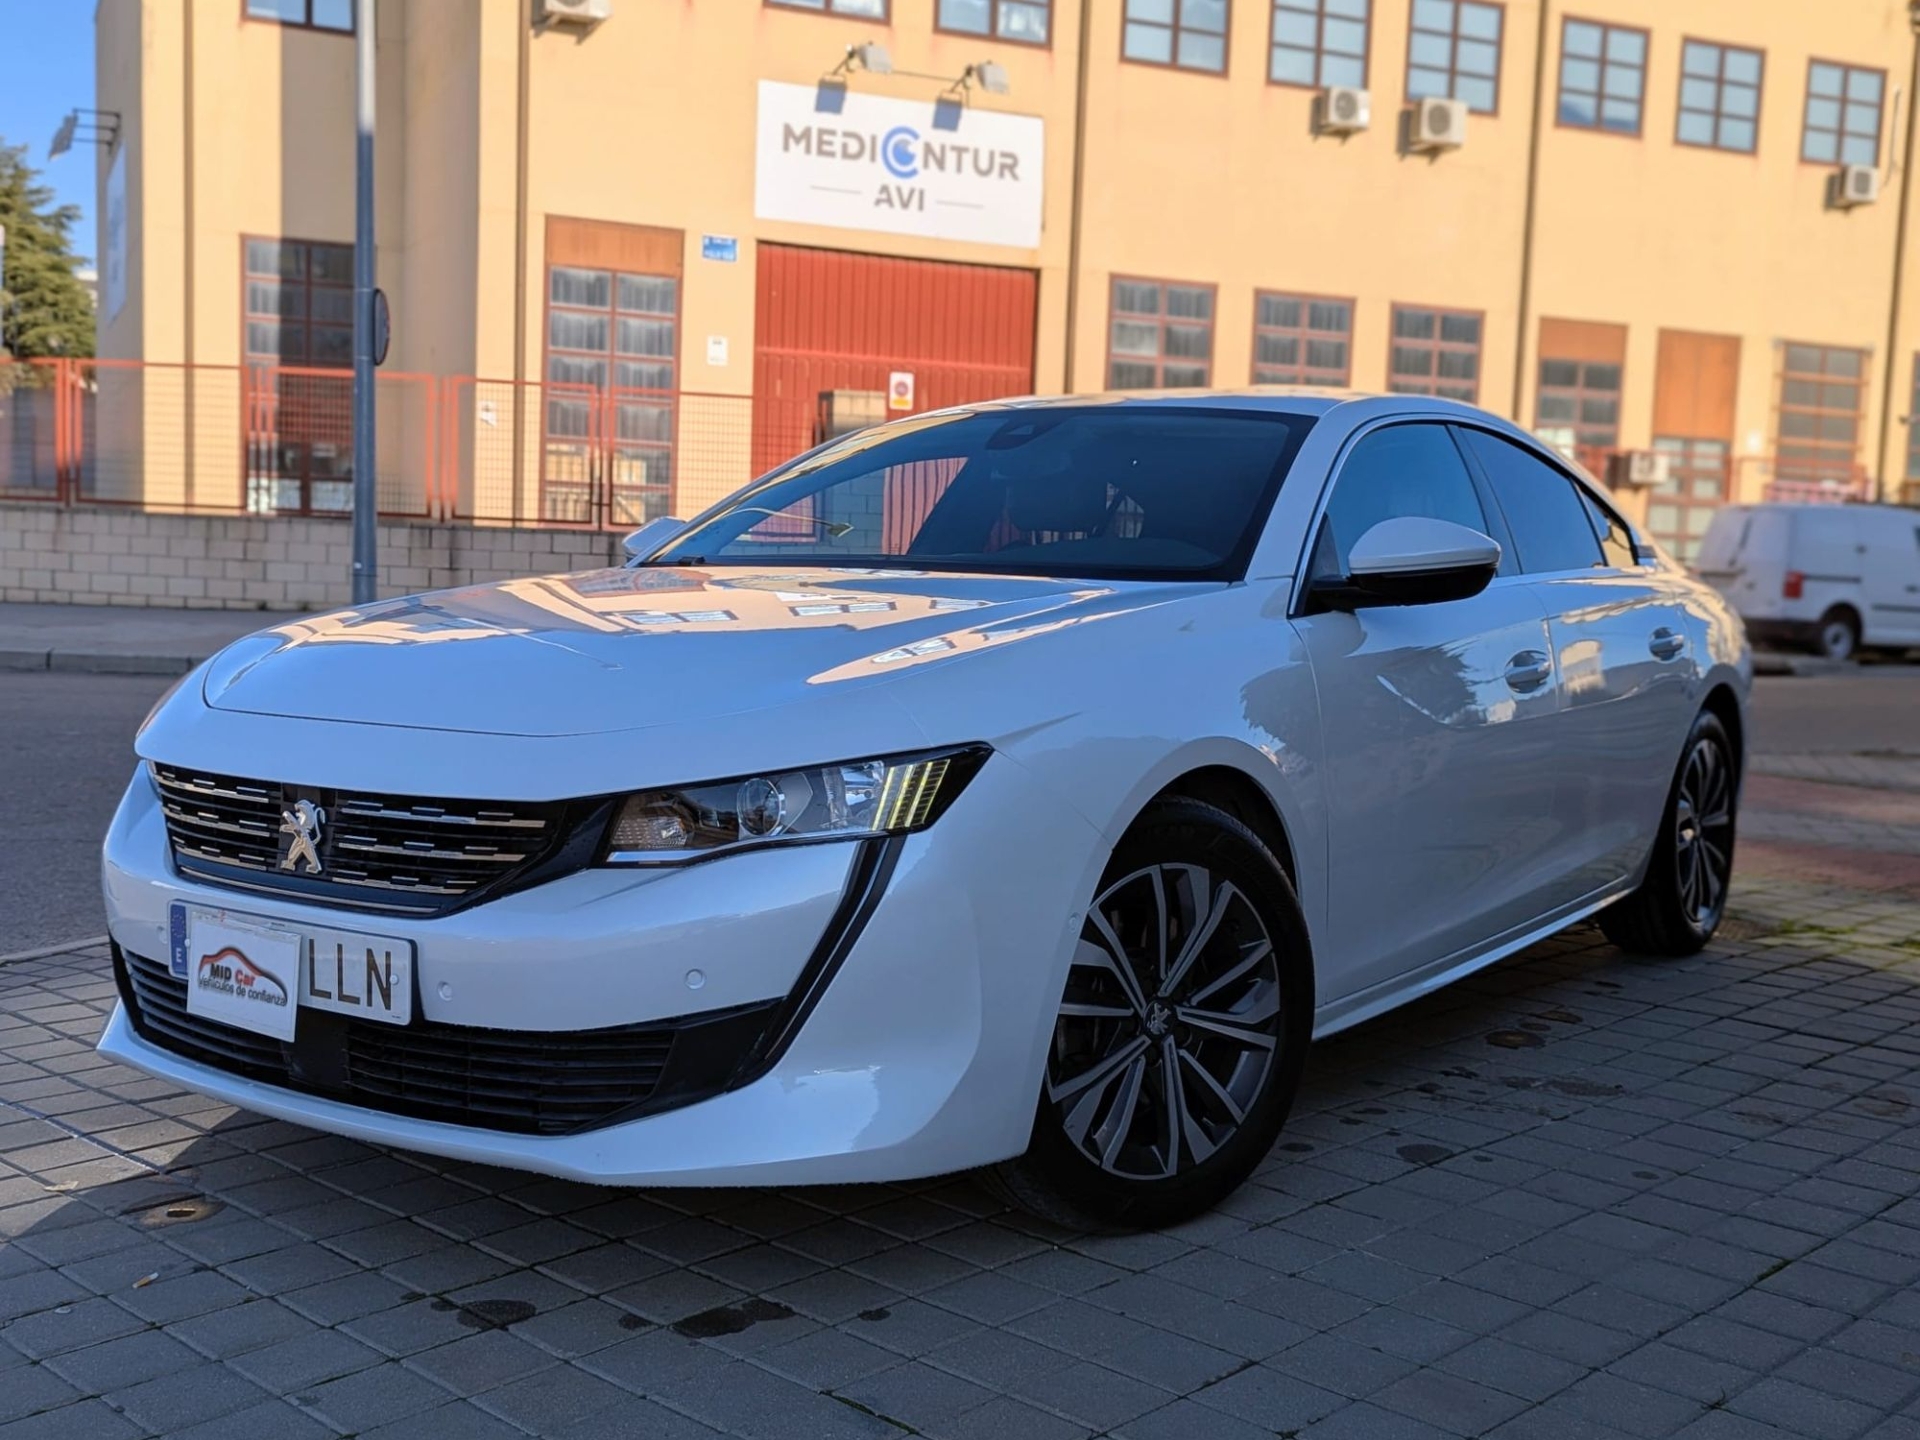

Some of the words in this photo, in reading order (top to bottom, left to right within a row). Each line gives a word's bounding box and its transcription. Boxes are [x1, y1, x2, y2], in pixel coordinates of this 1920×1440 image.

[874, 184, 925, 211] AVI
[175, 947, 183, 963] E
[210, 963, 232, 980] MID
[234, 968, 256, 987] Car
[308, 938, 392, 1011] LLN
[235, 984, 247, 997] de
[247, 988, 287, 1007] confianza
